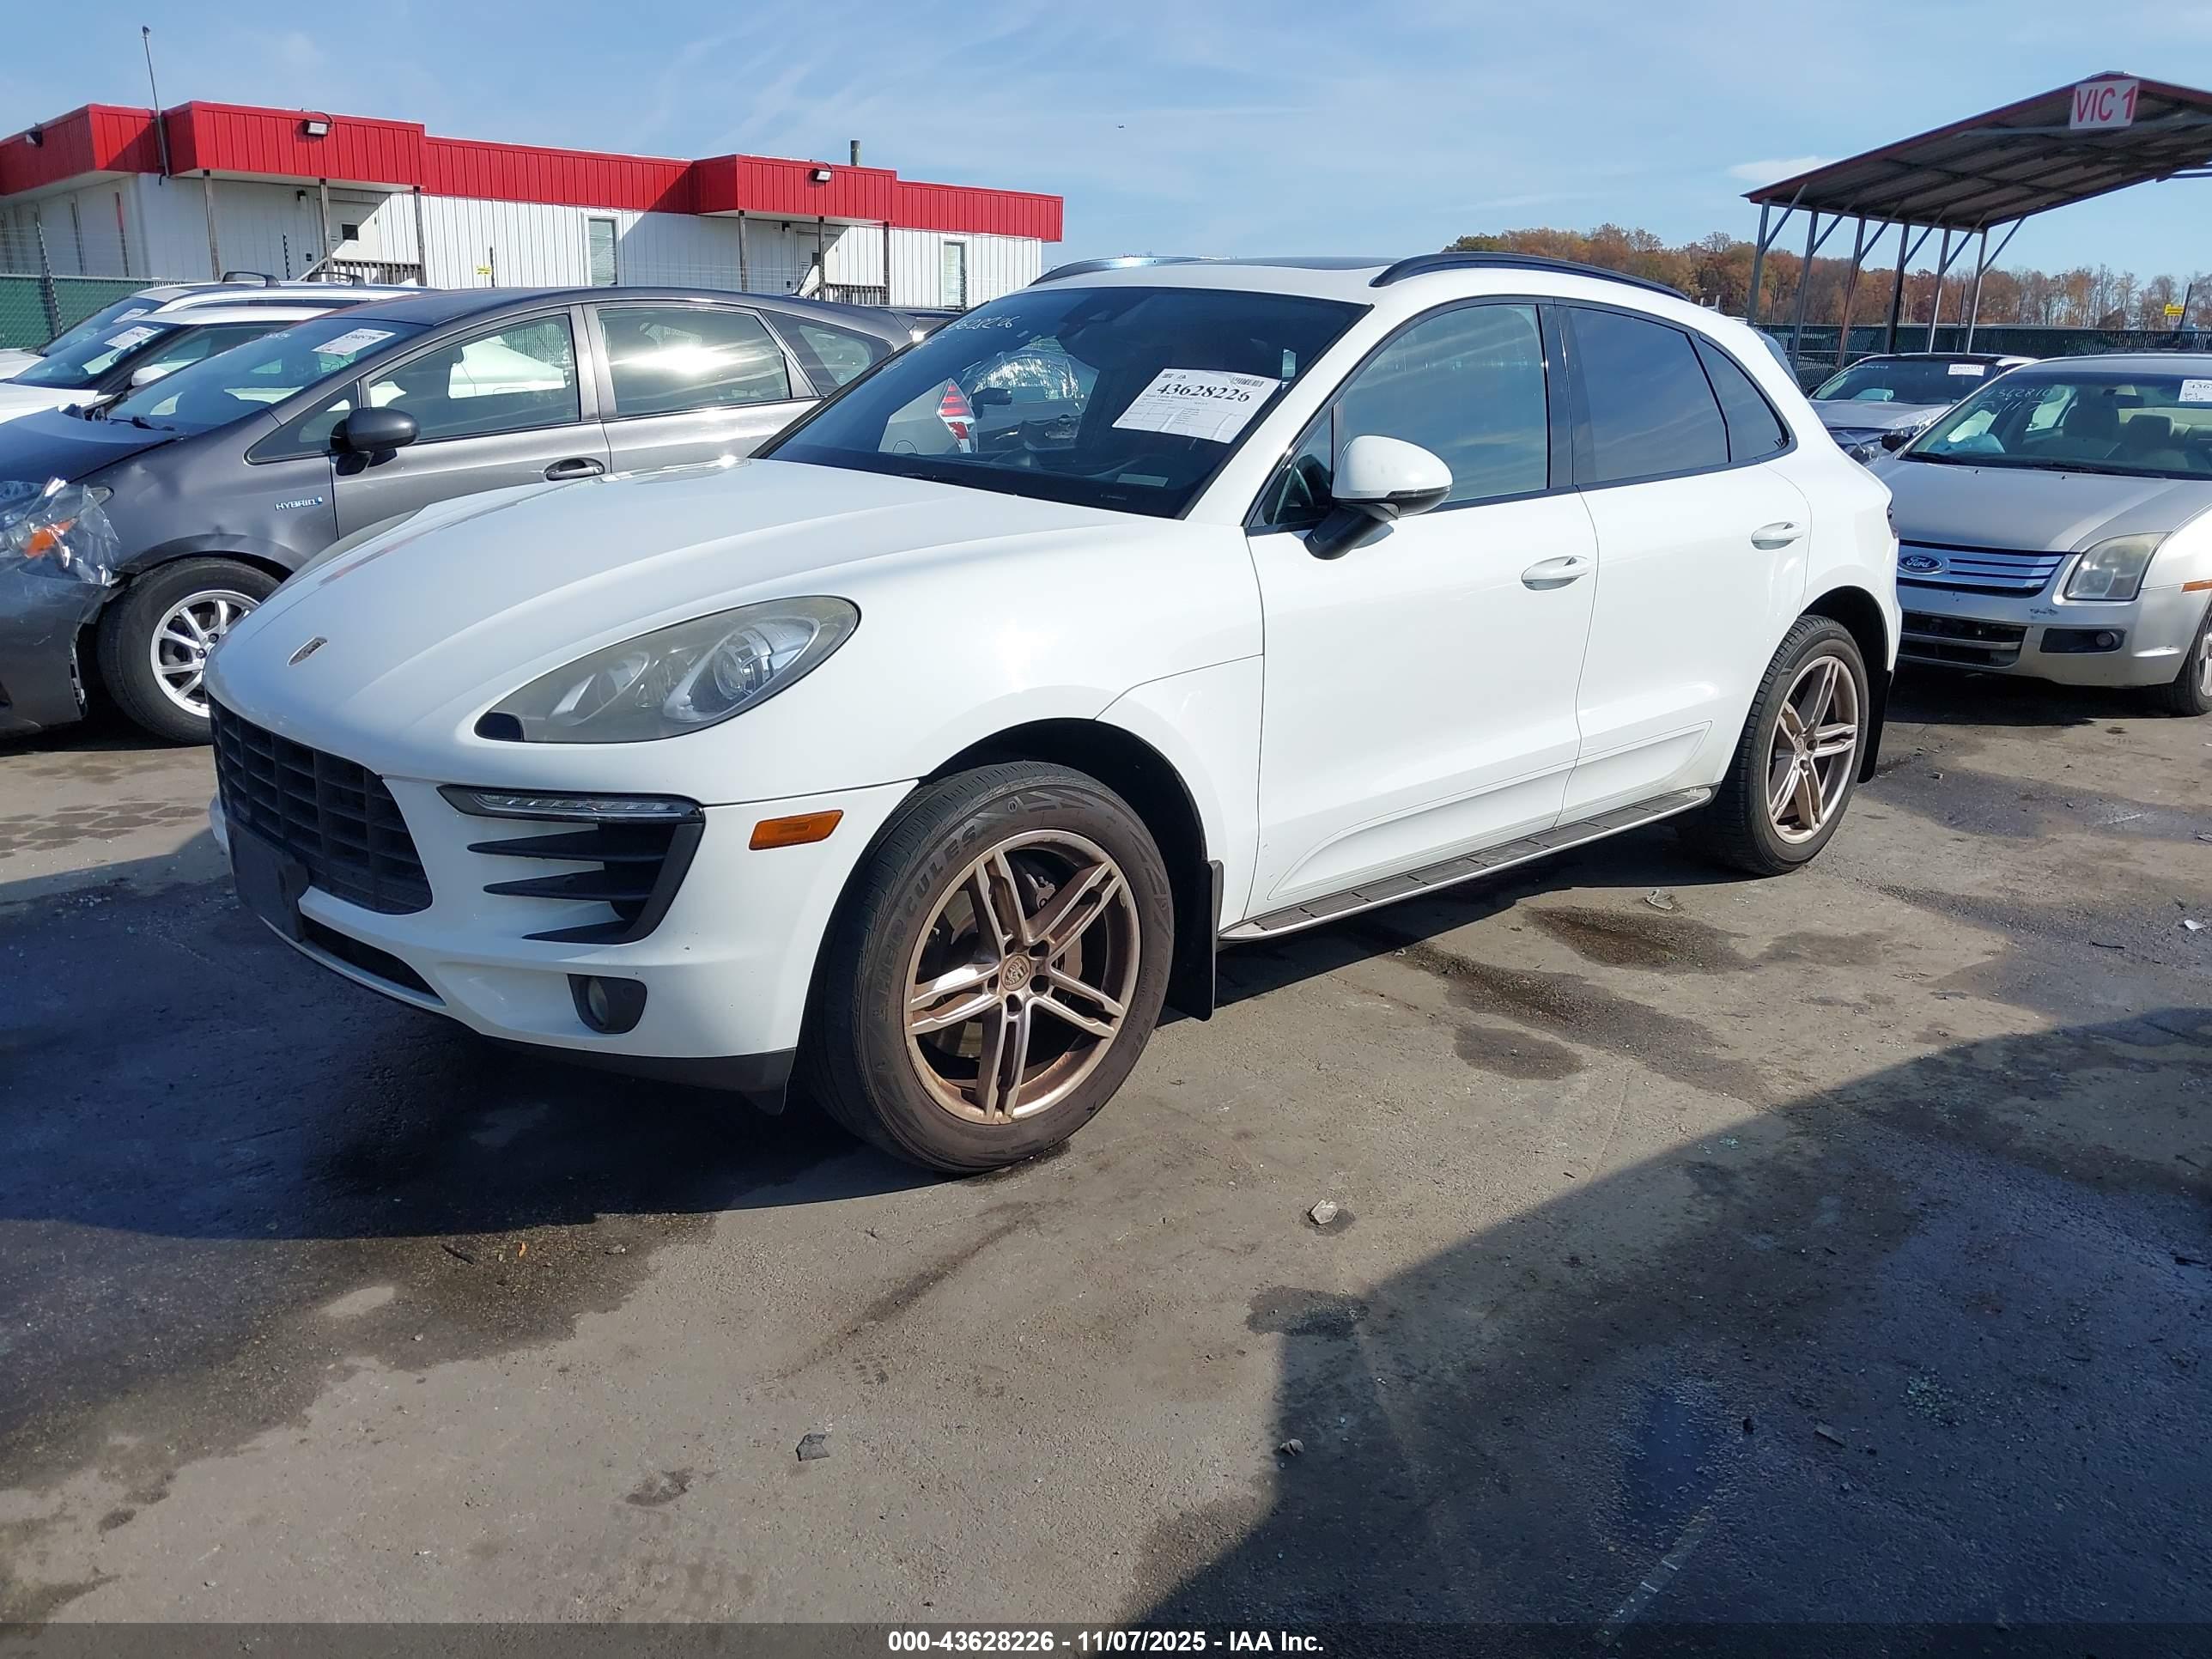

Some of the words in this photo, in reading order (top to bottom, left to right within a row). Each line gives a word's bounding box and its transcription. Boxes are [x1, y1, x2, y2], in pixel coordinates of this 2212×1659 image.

[2076, 88, 2116, 122] VIC
[2122, 85, 2136, 120] 1
[1157, 383, 1254, 403] 43628226
[1906, 556, 1931, 568] Ford
